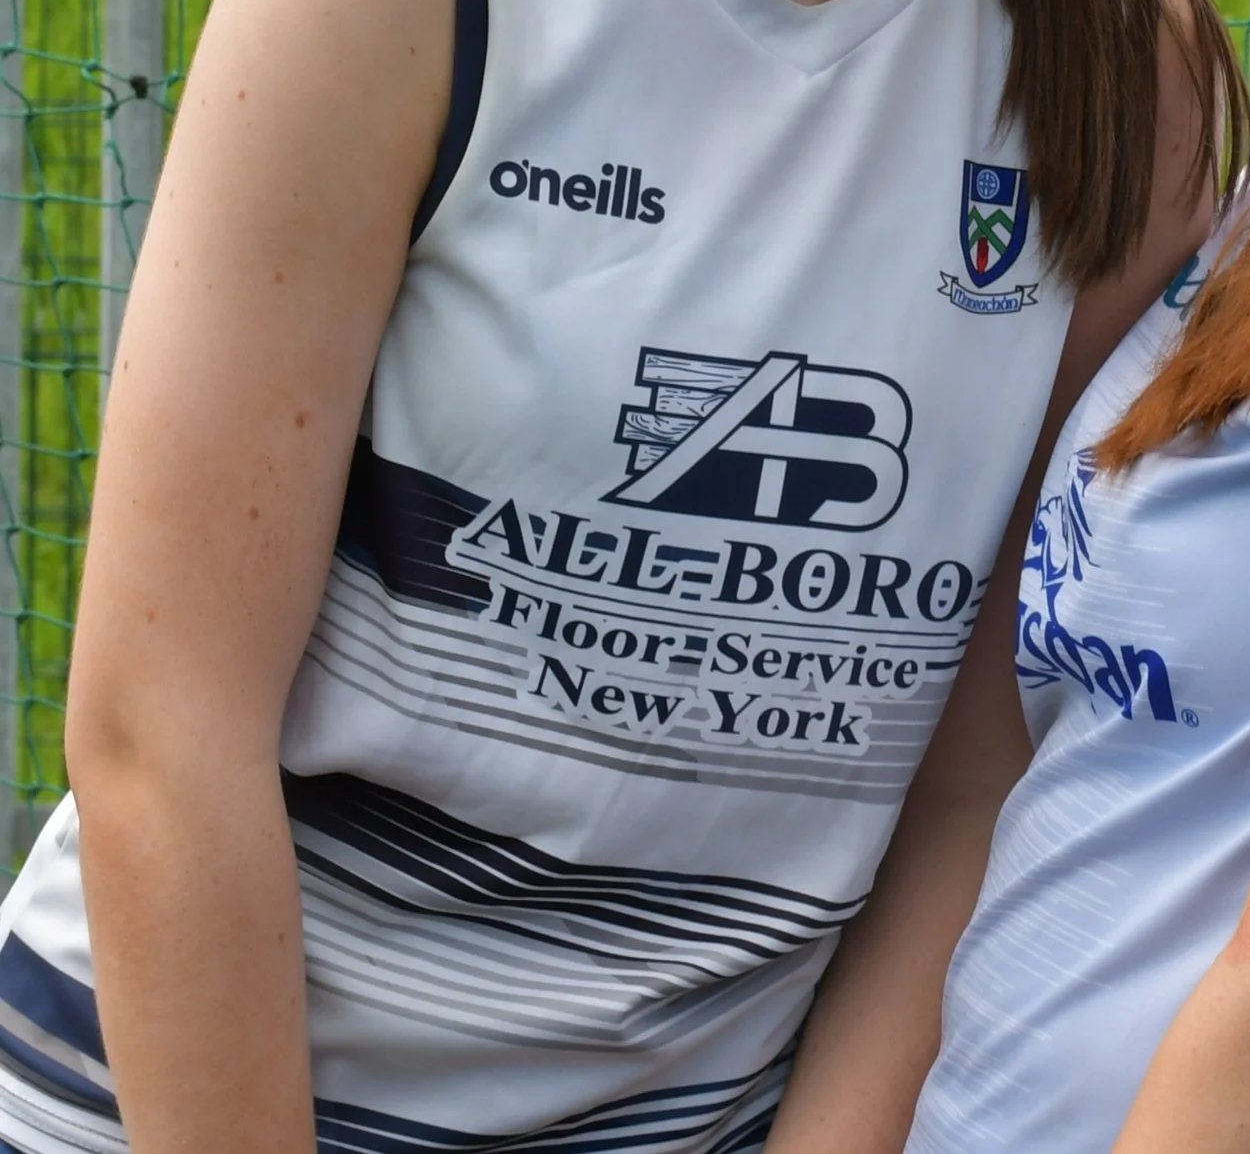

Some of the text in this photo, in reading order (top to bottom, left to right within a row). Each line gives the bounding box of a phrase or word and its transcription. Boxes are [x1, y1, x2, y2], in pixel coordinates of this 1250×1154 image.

[489, 159, 666, 225] o'neills
[489, 584, 920, 690] Floor Service
[529, 654, 864, 745] New York
